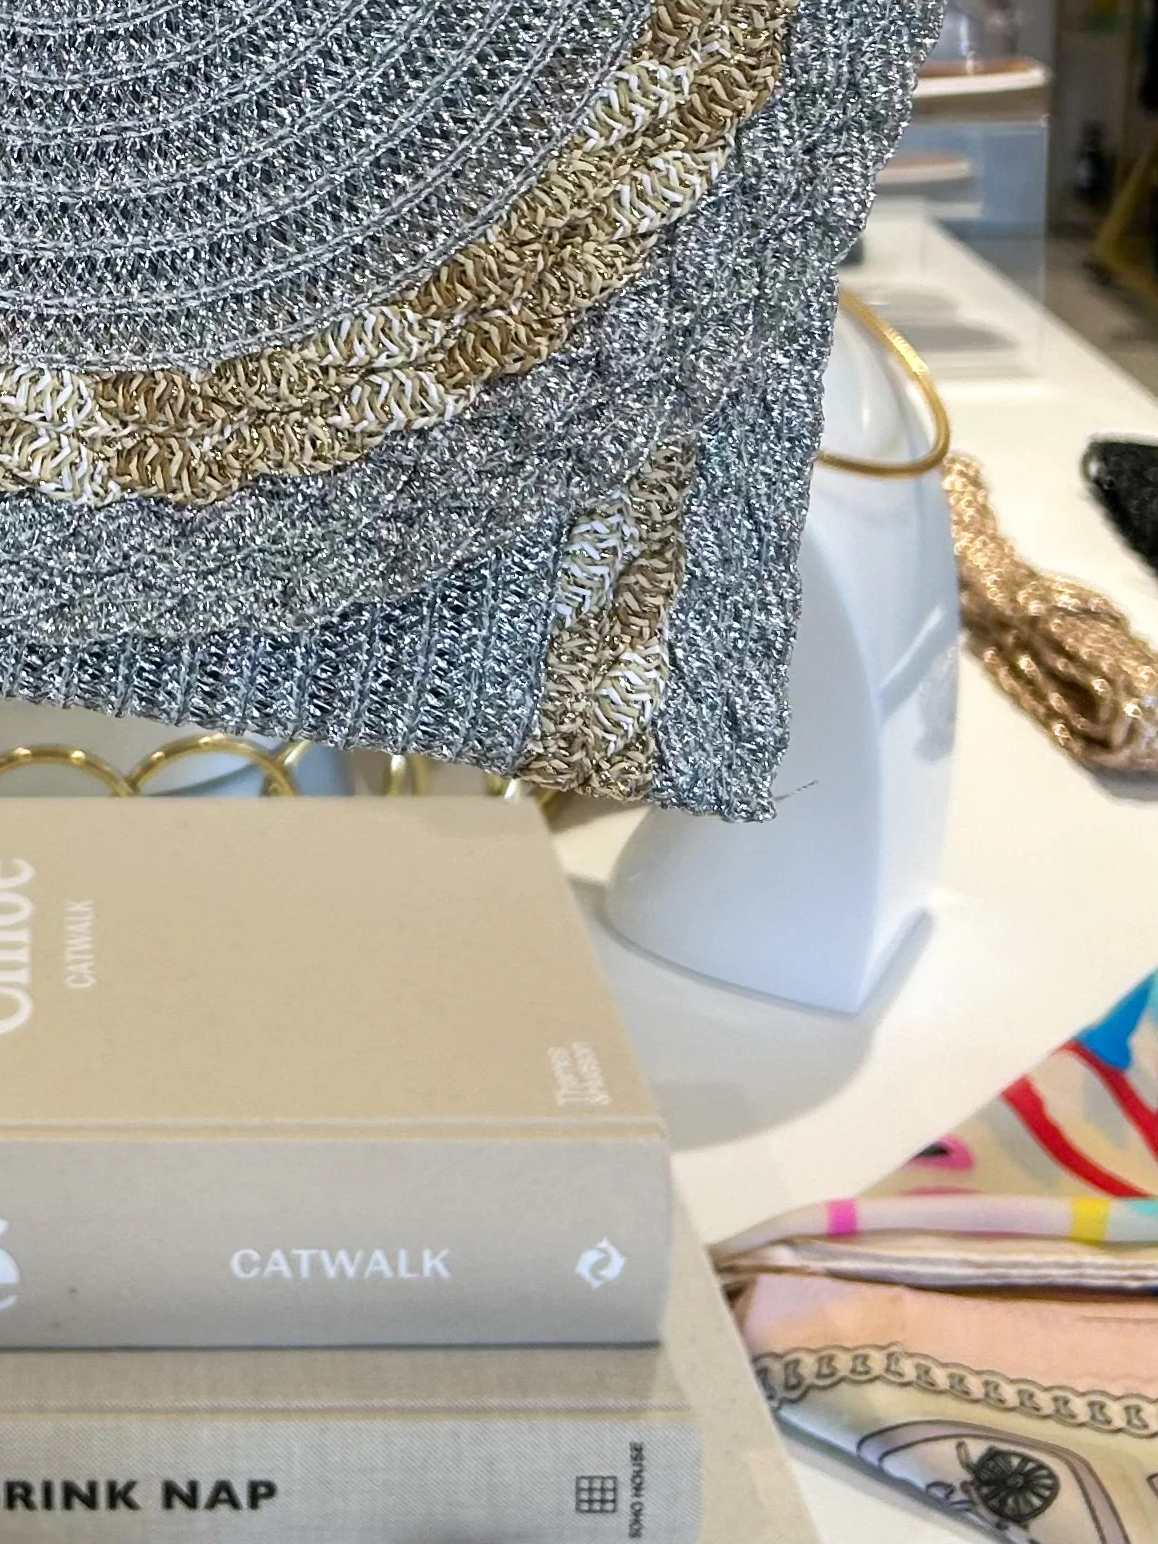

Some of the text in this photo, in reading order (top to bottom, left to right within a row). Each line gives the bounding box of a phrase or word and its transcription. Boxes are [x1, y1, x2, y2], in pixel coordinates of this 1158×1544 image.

[64, 900, 96, 988] CATWALK
[230, 1248, 451, 1280] CATWALK
[161, 1479, 278, 1511] NAP
